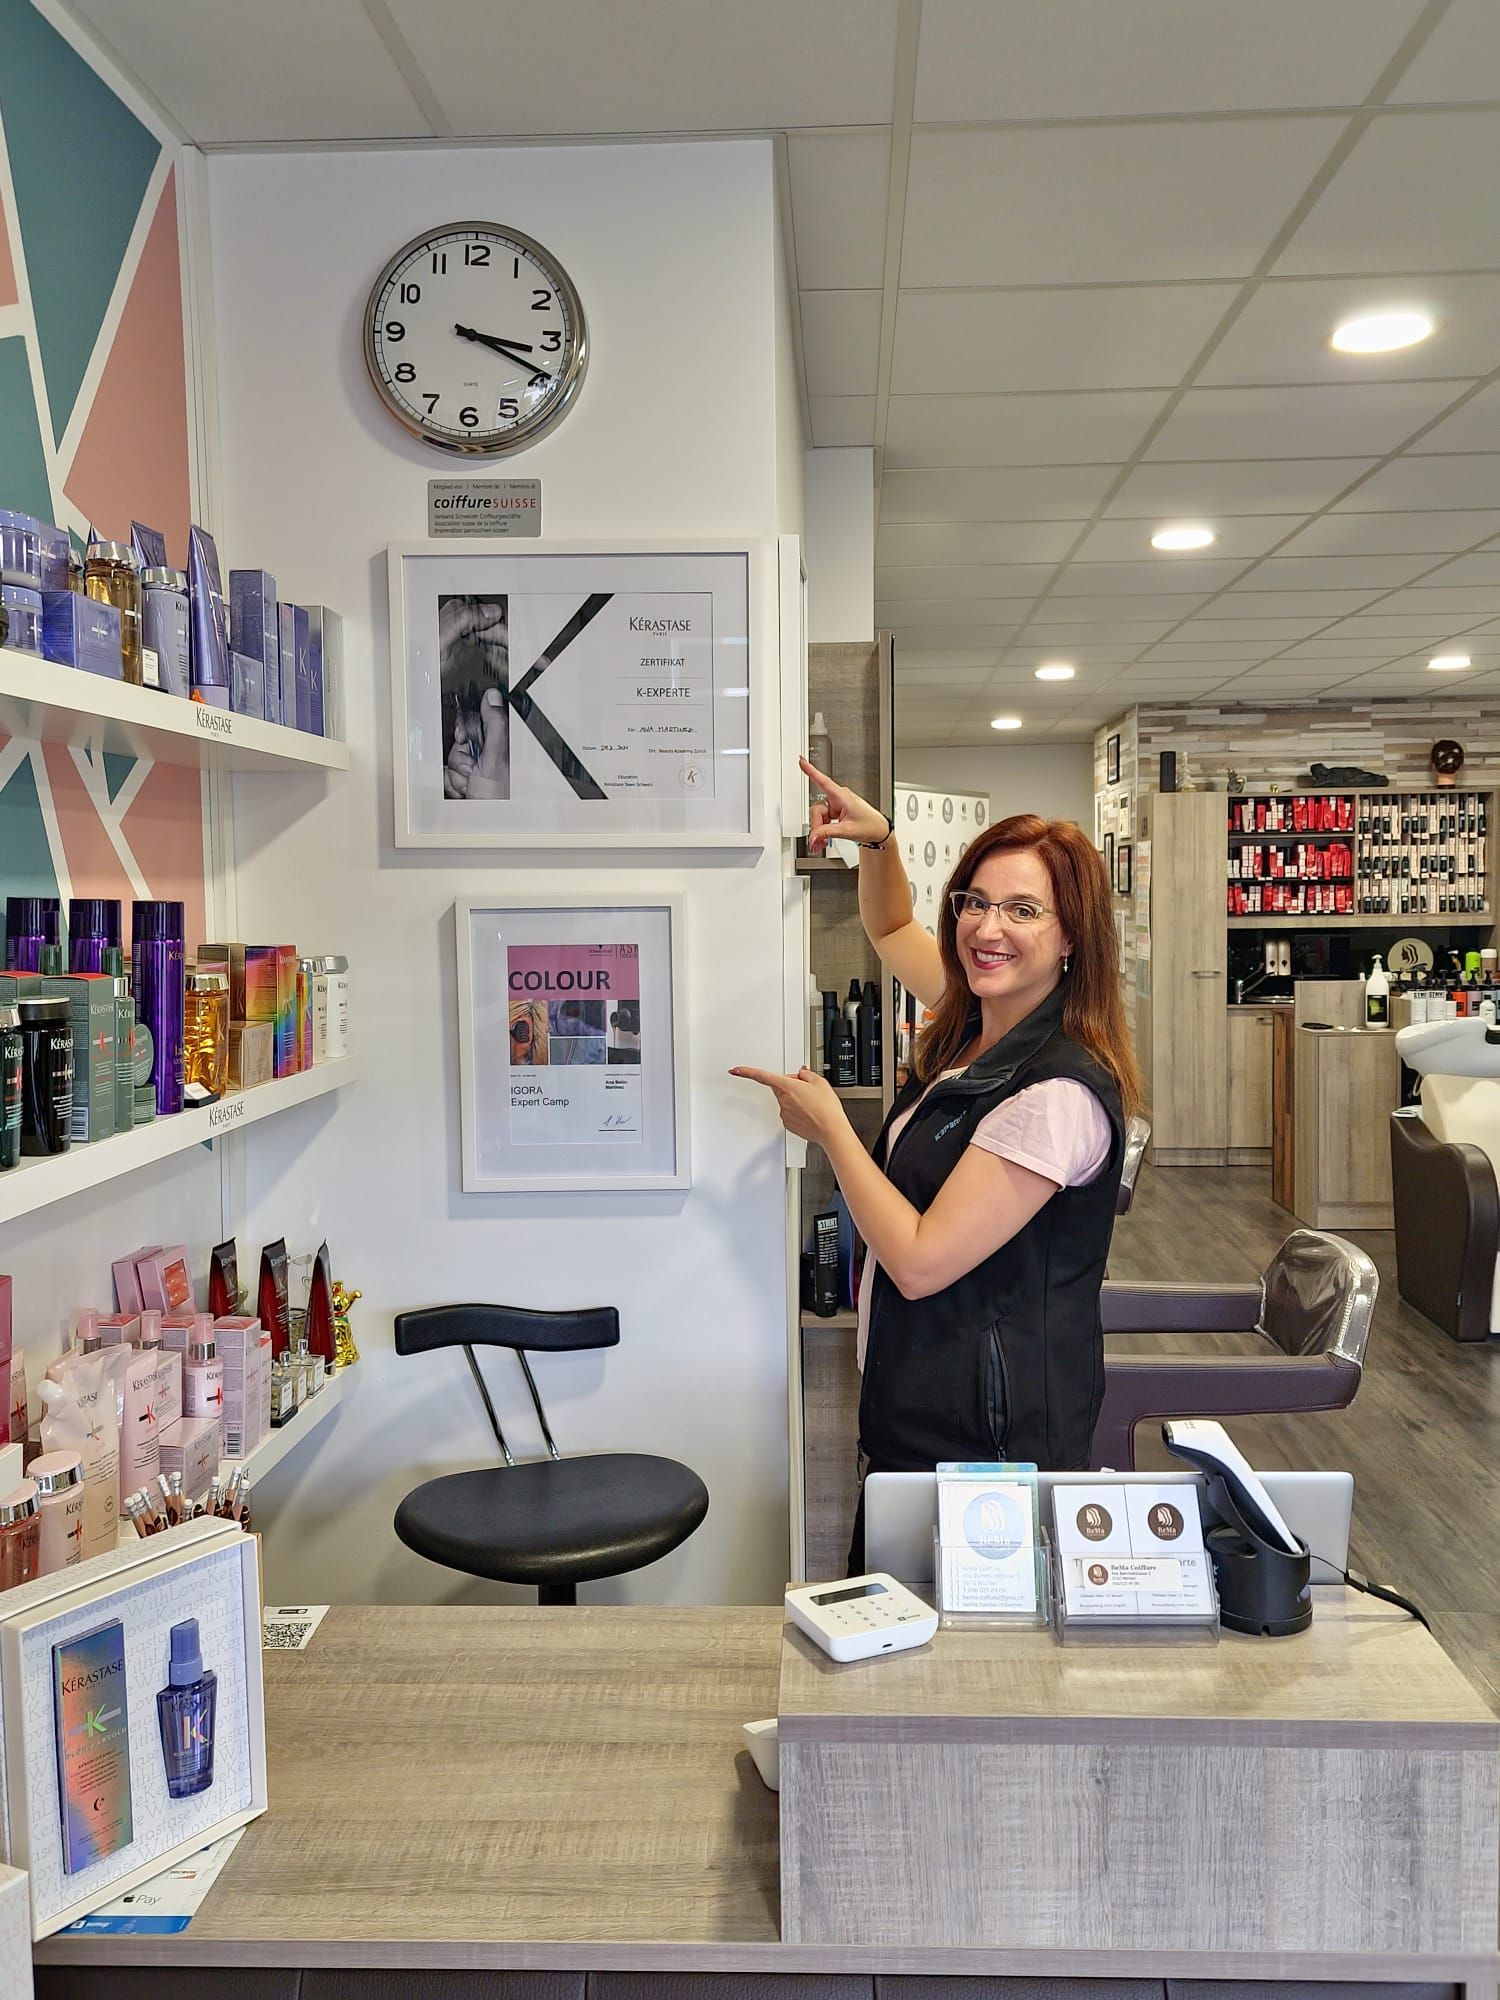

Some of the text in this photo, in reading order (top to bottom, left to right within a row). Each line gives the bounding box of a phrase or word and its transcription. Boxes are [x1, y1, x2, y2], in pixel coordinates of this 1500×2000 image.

[432, 253, 447, 275] 11
[464, 244, 491, 266] 12
[513, 257, 519, 279] 1
[400, 283, 421, 304] 10
[531, 290, 552, 311] 2
[385, 321, 406, 342] 9
[540, 330, 562, 352] 3
[394, 362, 416, 383] 8
[422, 393, 440, 414] 7
[498, 398, 519, 419] 5
[459, 406, 479, 427] 6
[629, 616, 692, 631] KÉRASTASE
[640, 658, 685, 667] ZERTIFIKAT
[637, 687, 690, 698] K-EXPERTE
[196, 706, 232, 734] KÉRASTASE
[508, 970, 611, 991] COLOUR
[510, 1086, 543, 1095] IGORA
[511, 1098, 570, 1108] Expert Camp
[208, 1101, 244, 1128] KÉRASTASE
[62, 1659, 123, 1697] KÉRASTASE
[136, 1894, 163, 1906] Pay
